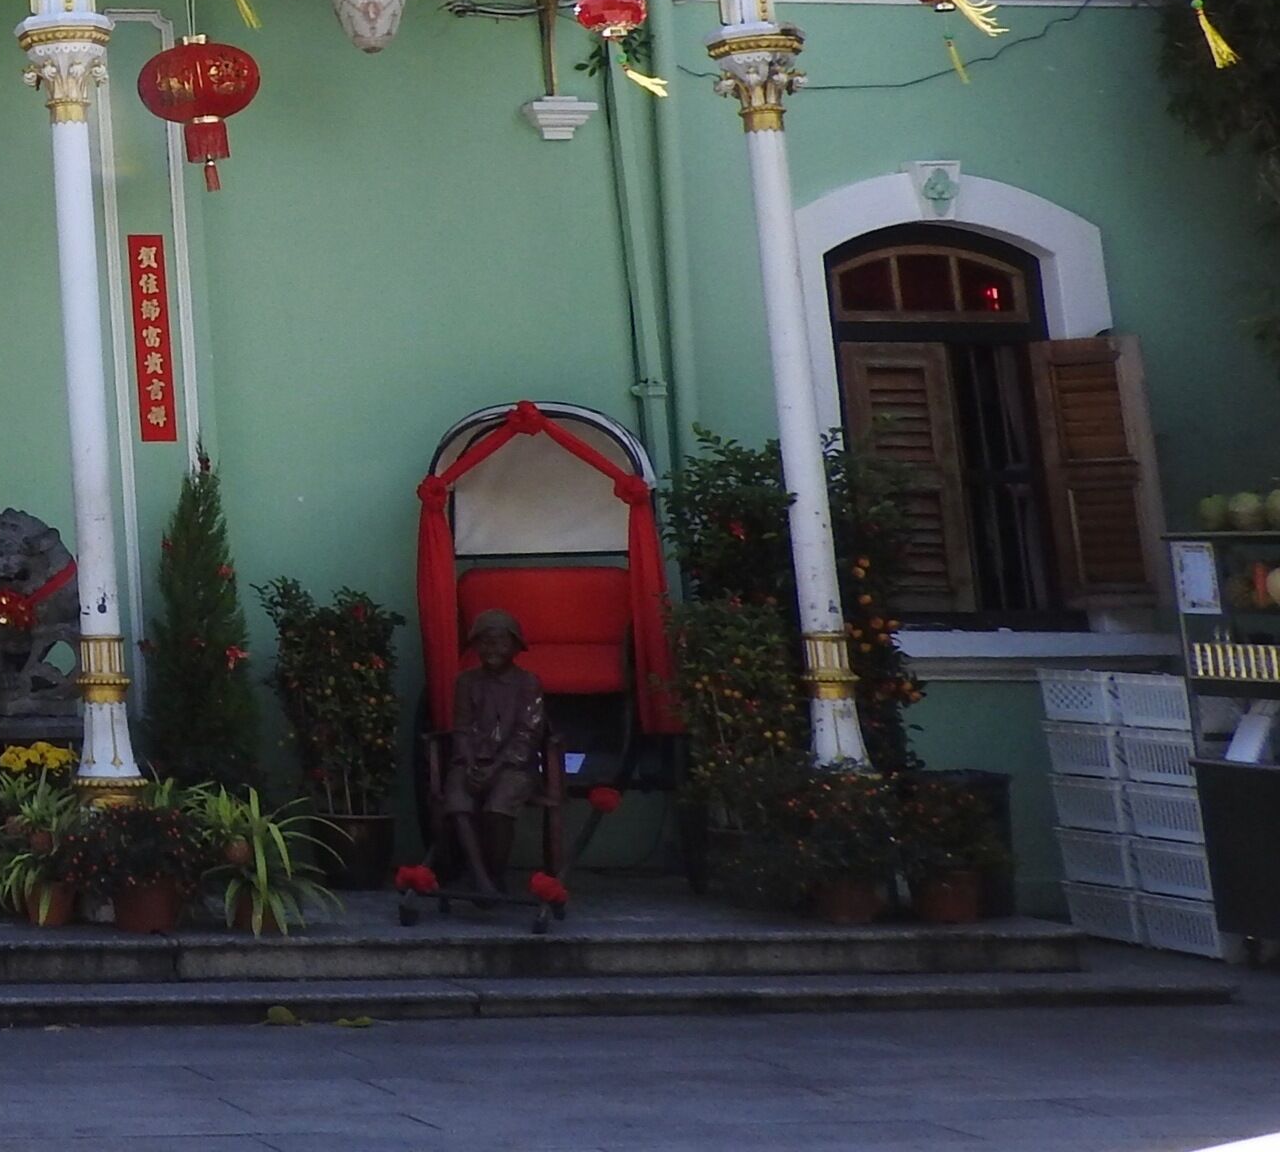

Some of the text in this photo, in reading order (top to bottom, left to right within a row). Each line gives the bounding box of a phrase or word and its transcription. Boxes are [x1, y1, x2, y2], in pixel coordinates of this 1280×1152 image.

[137, 245, 168, 428] 賀佳節富貴吉祥
